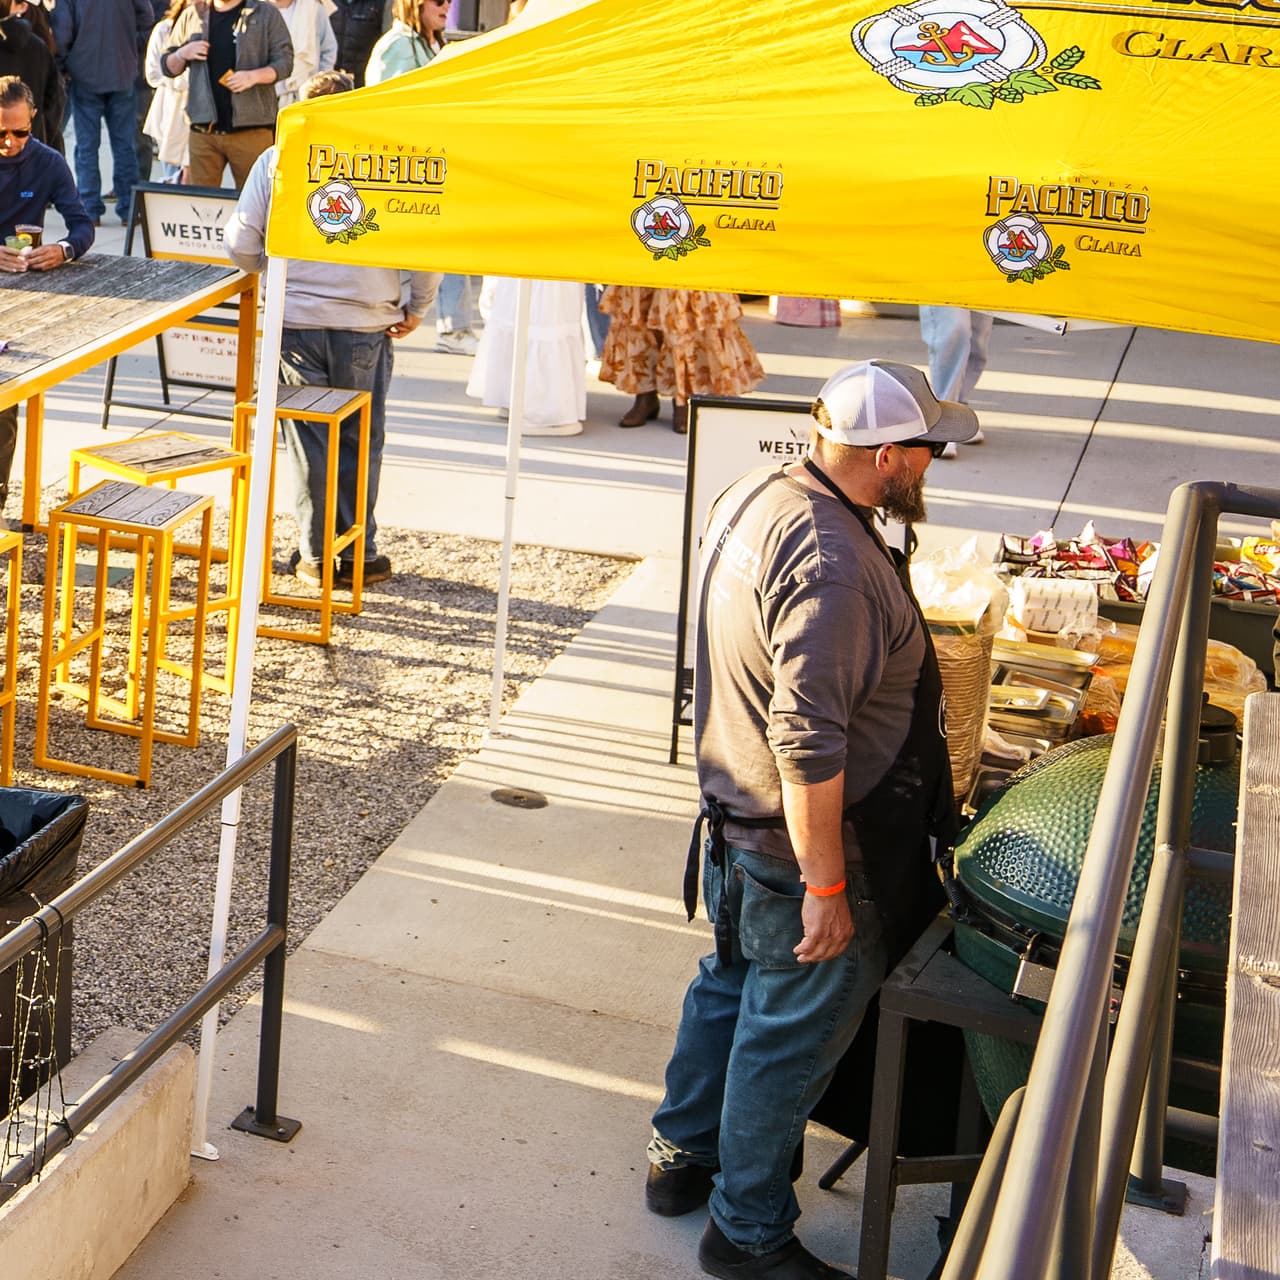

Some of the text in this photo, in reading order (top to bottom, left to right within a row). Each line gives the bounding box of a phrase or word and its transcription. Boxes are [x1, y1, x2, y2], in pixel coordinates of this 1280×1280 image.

[354, 144, 447, 154] CERVEZA
[308, 144, 447, 184] PACIFICO
[684, 158, 784, 169] CERVEZA
[633, 158, 784, 200] PACIFICO
[1041, 175, 1149, 192] CERVEZA
[385, 197, 441, 216] CLARA
[985, 176, 1151, 223] PACIFICO
[715, 214, 777, 232] CLARA
[1074, 234, 1142, 257] CLARA
